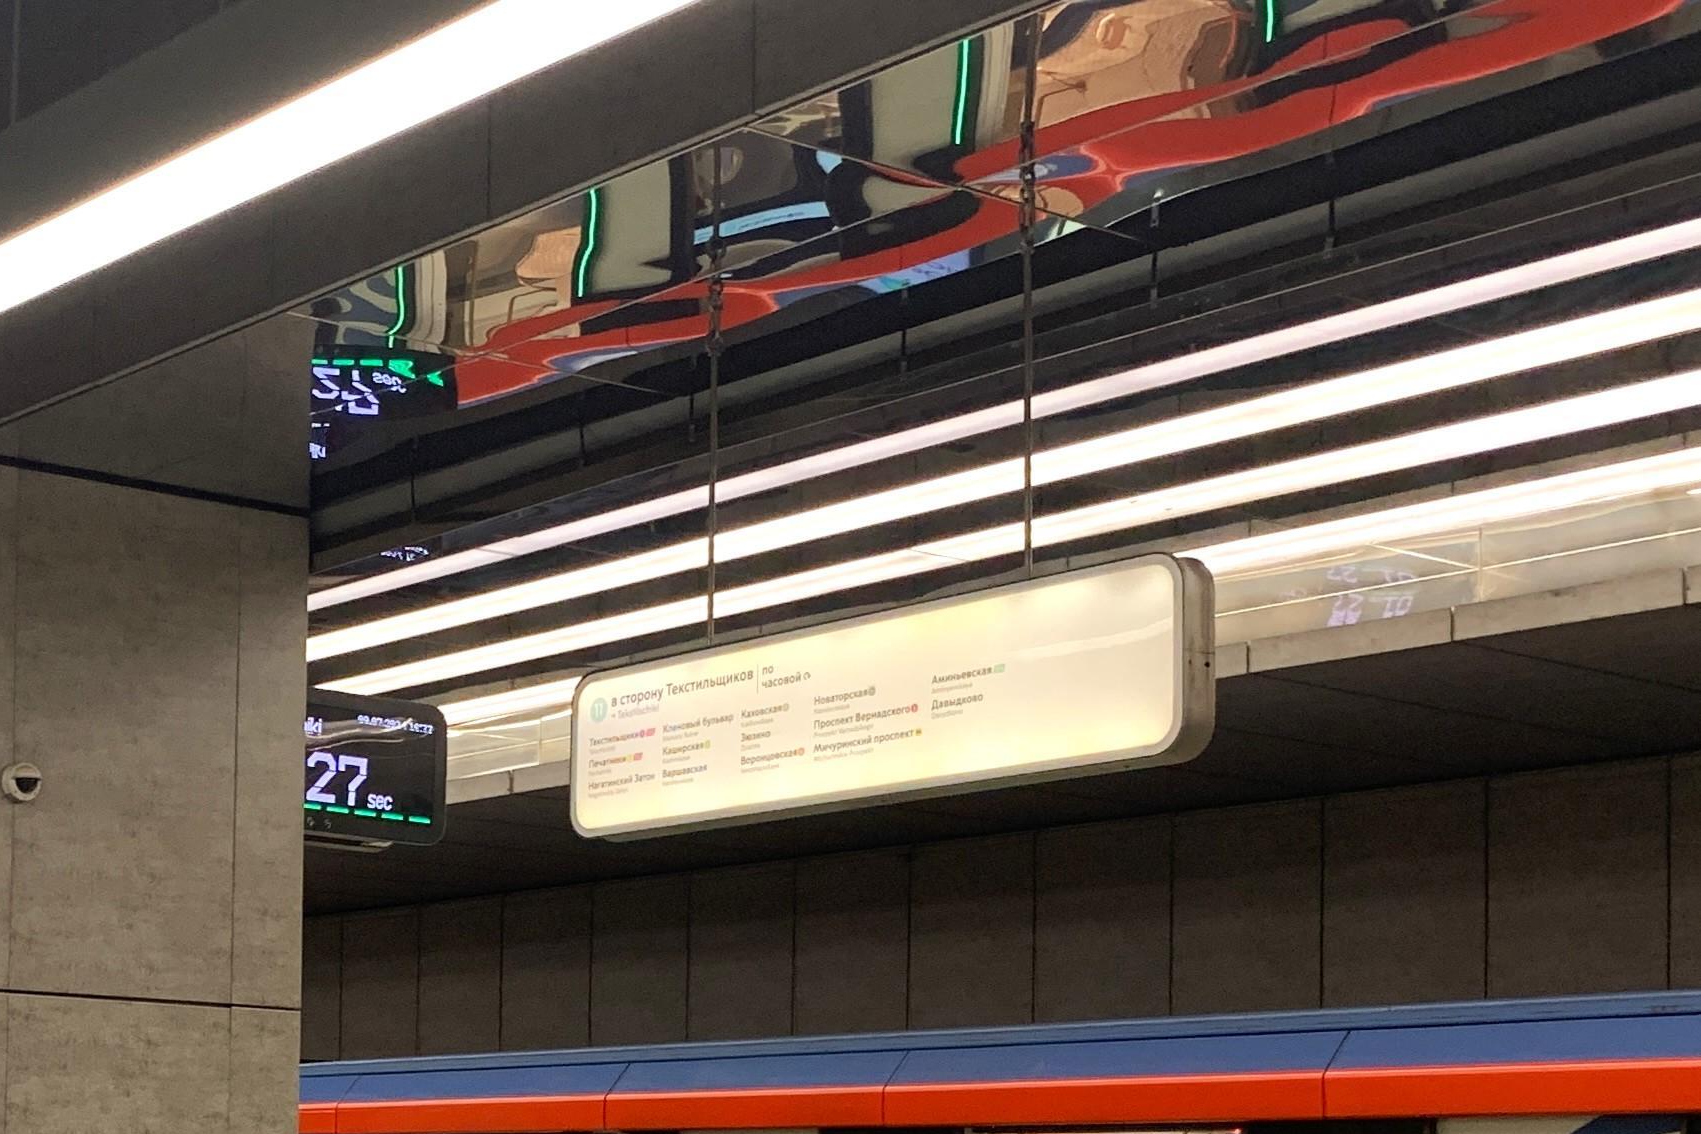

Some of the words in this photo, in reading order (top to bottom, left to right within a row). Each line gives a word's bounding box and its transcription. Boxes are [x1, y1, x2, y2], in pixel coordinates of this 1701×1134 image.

[761, 664, 775, 676] по
[611, 697, 618, 708] в
[620, 687, 663, 706] сторону
[666, 669, 754, 697] Текстильщиков
[761, 671, 802, 689] часовой
[813, 715, 854, 730] Проспект
[873, 728, 915, 744] проспект
[306, 750, 368, 807] 27
[366, 793, 394, 811] sec
